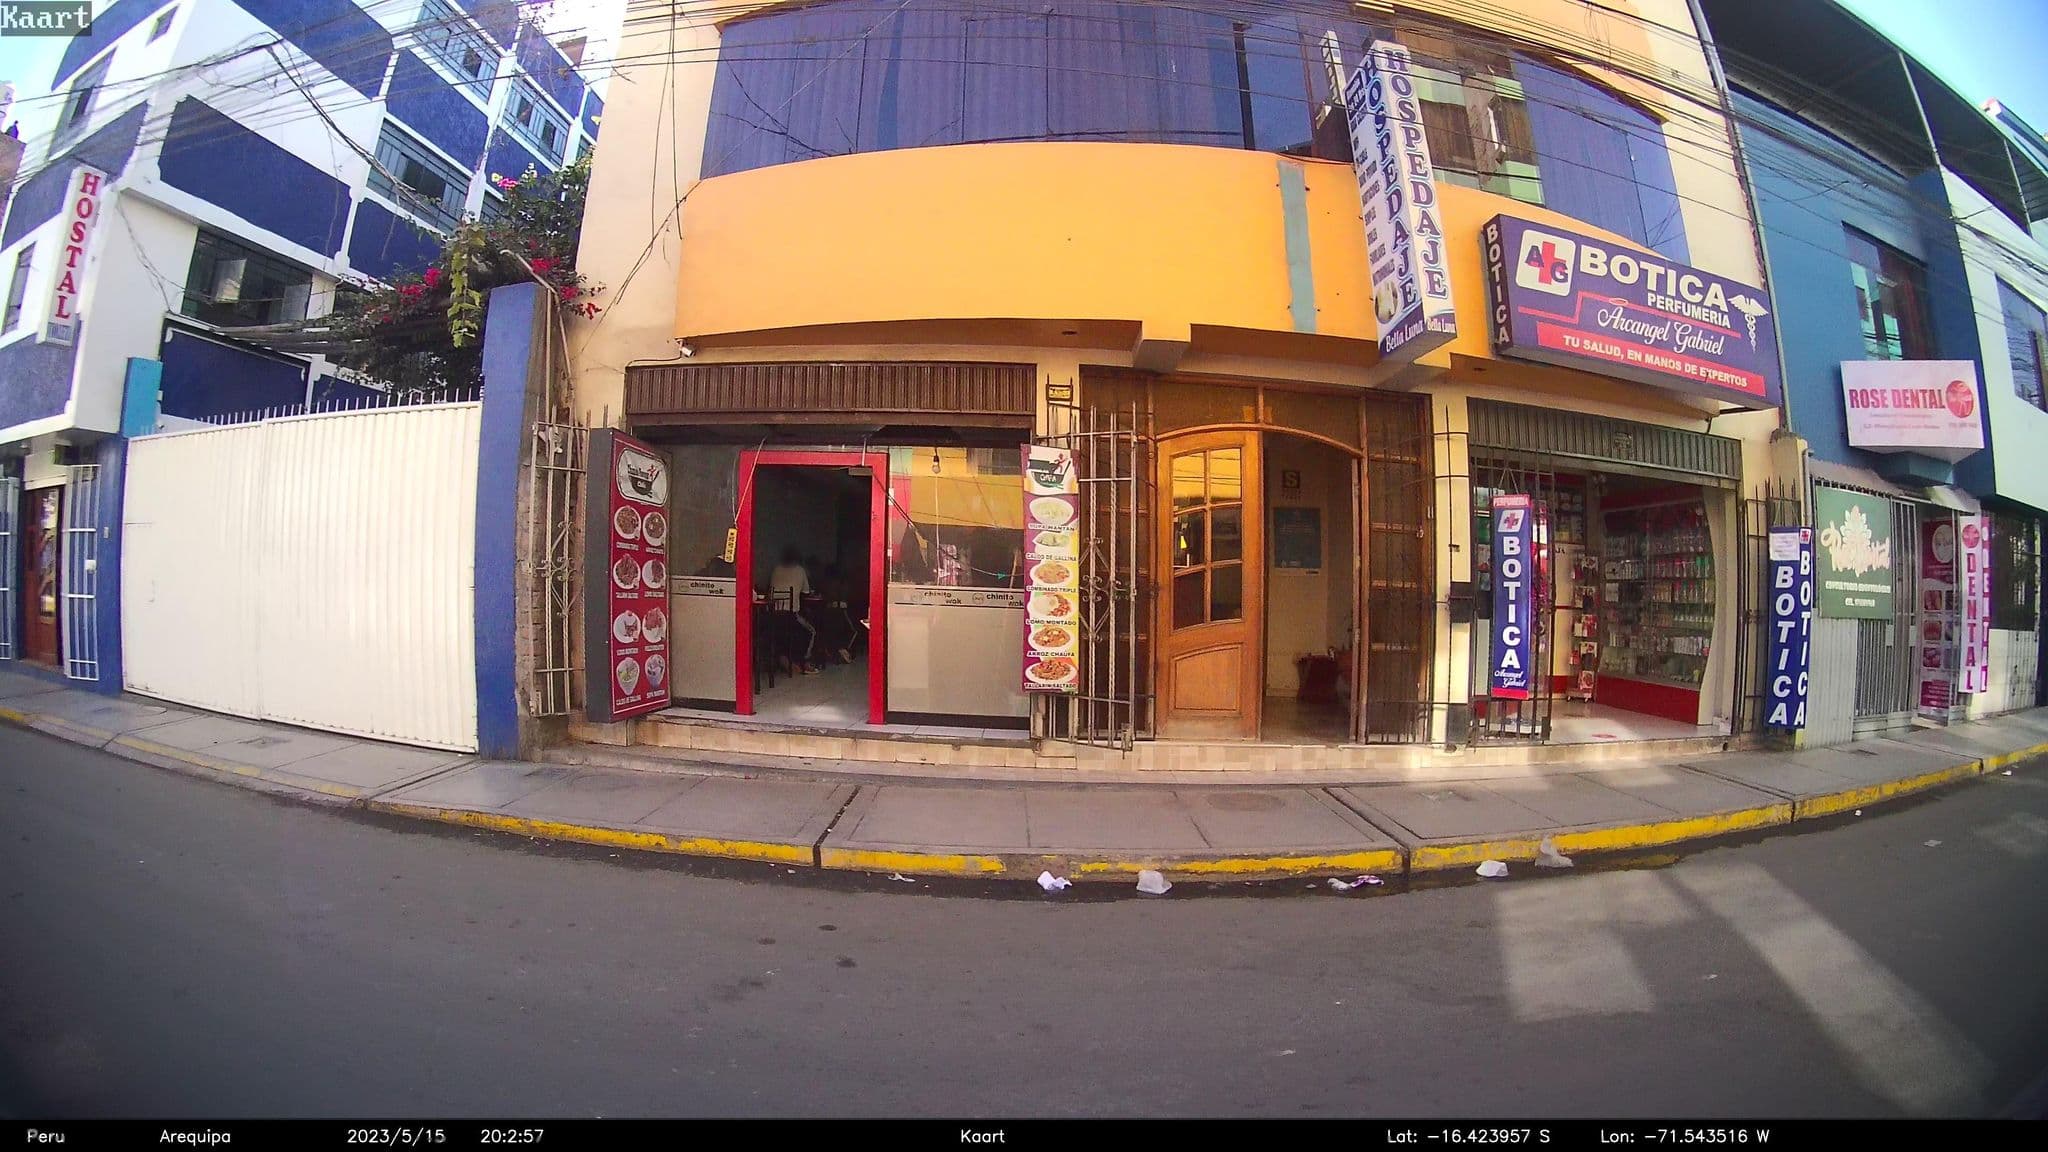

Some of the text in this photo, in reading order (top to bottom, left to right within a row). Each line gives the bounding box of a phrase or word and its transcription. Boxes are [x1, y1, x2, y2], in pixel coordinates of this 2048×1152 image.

[1363, 54, 1418, 310] HOSPEDAJE
[1383, 48, 1447, 299] HOSPEDAJE
[55, 172, 101, 320] HOSTAL
[1486, 223, 1511, 345] BOTICA
[1579, 244, 1728, 313] BOTICA
[1386, 319, 1425, 353] Bella Luna
[1563, 334, 1748, 388] TU SALUD, EN MANOS DE EXPERTOS
[1597, 305, 1725, 354] Arcangel Gabriel
[1647, 292, 1732, 329] PERFUMERIA
[1848, 389, 1946, 409] ROSE DENTAL
[1501, 535, 1522, 669] BOTICA
[1769, 565, 1796, 725] BOTICA
[1794, 550, 1812, 726] BOTICA
[1965, 552, 1977, 690] DENTAL
